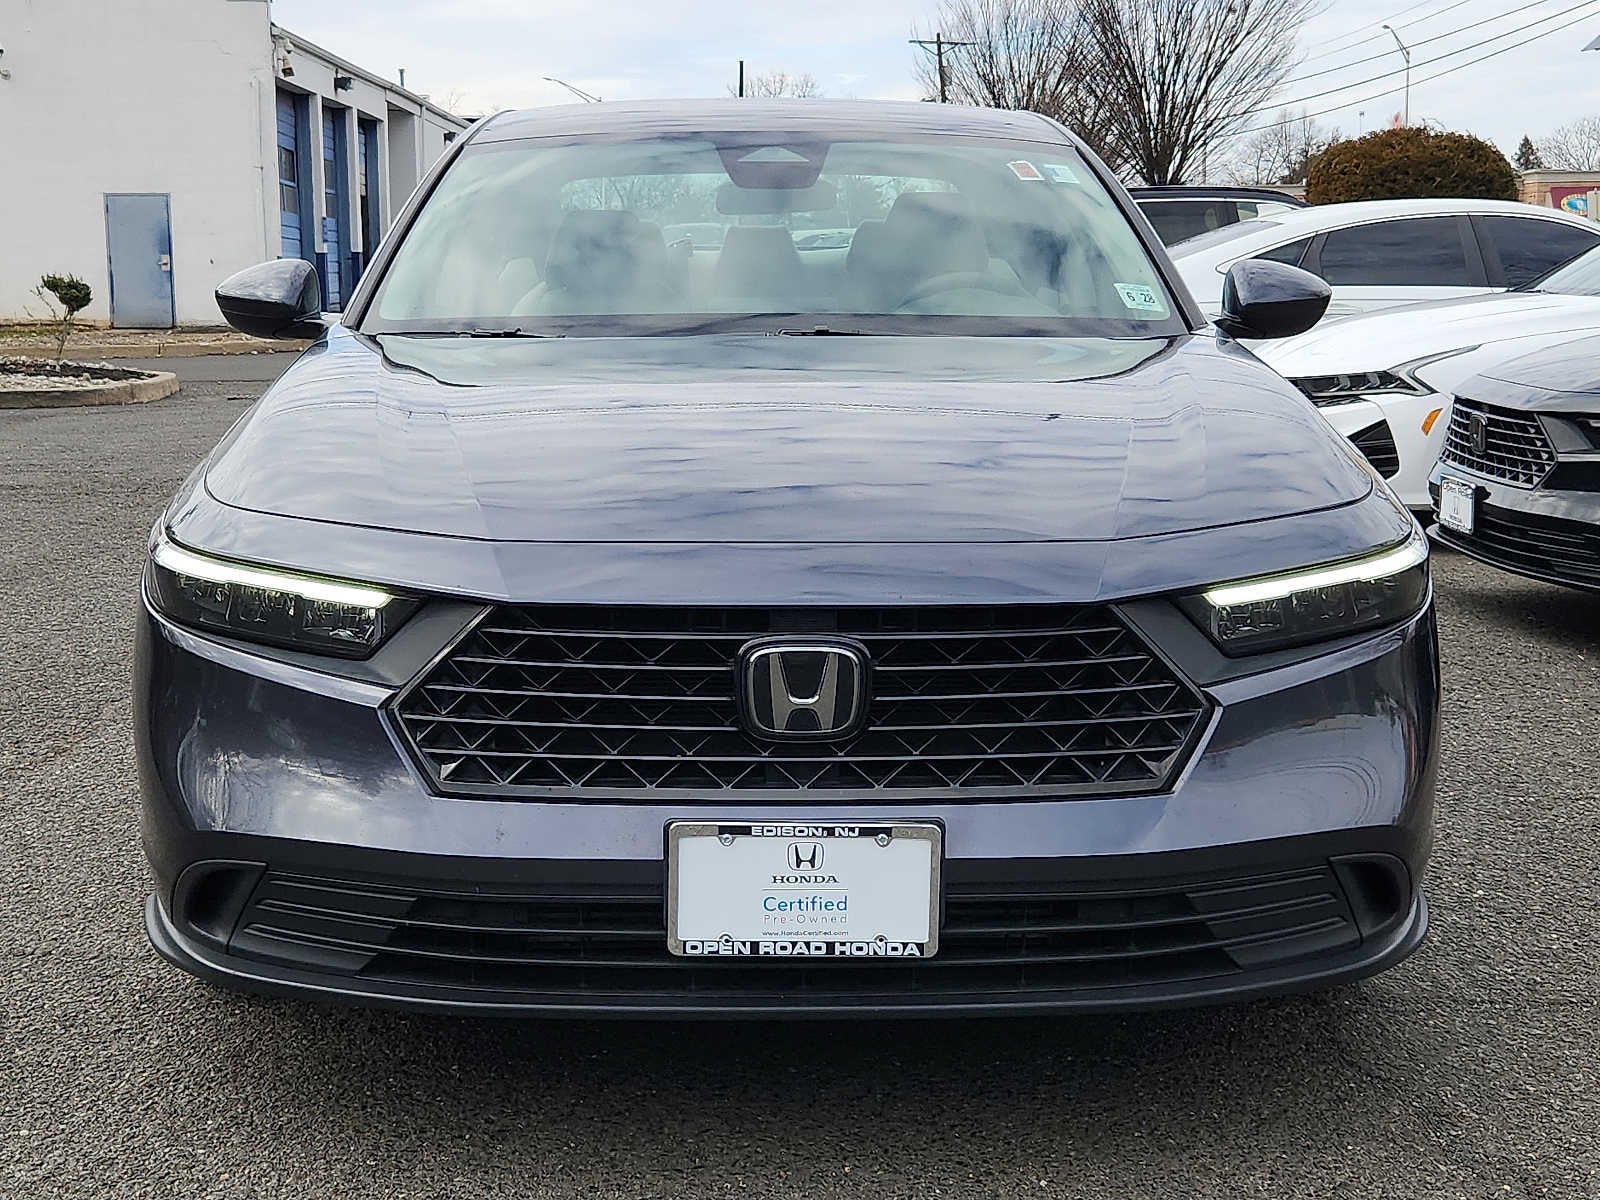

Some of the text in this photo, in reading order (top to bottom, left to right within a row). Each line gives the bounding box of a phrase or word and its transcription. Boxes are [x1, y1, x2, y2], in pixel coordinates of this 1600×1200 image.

[1126, 291, 1136, 301] 6
[751, 826, 860, 837] EDISON, NJ
[771, 875, 840, 884] HONDA
[763, 895, 848, 912] Certified
[763, 914, 848, 925] Pre-Owned
[685, 940, 921, 957] OPEN ROAD HONDA
